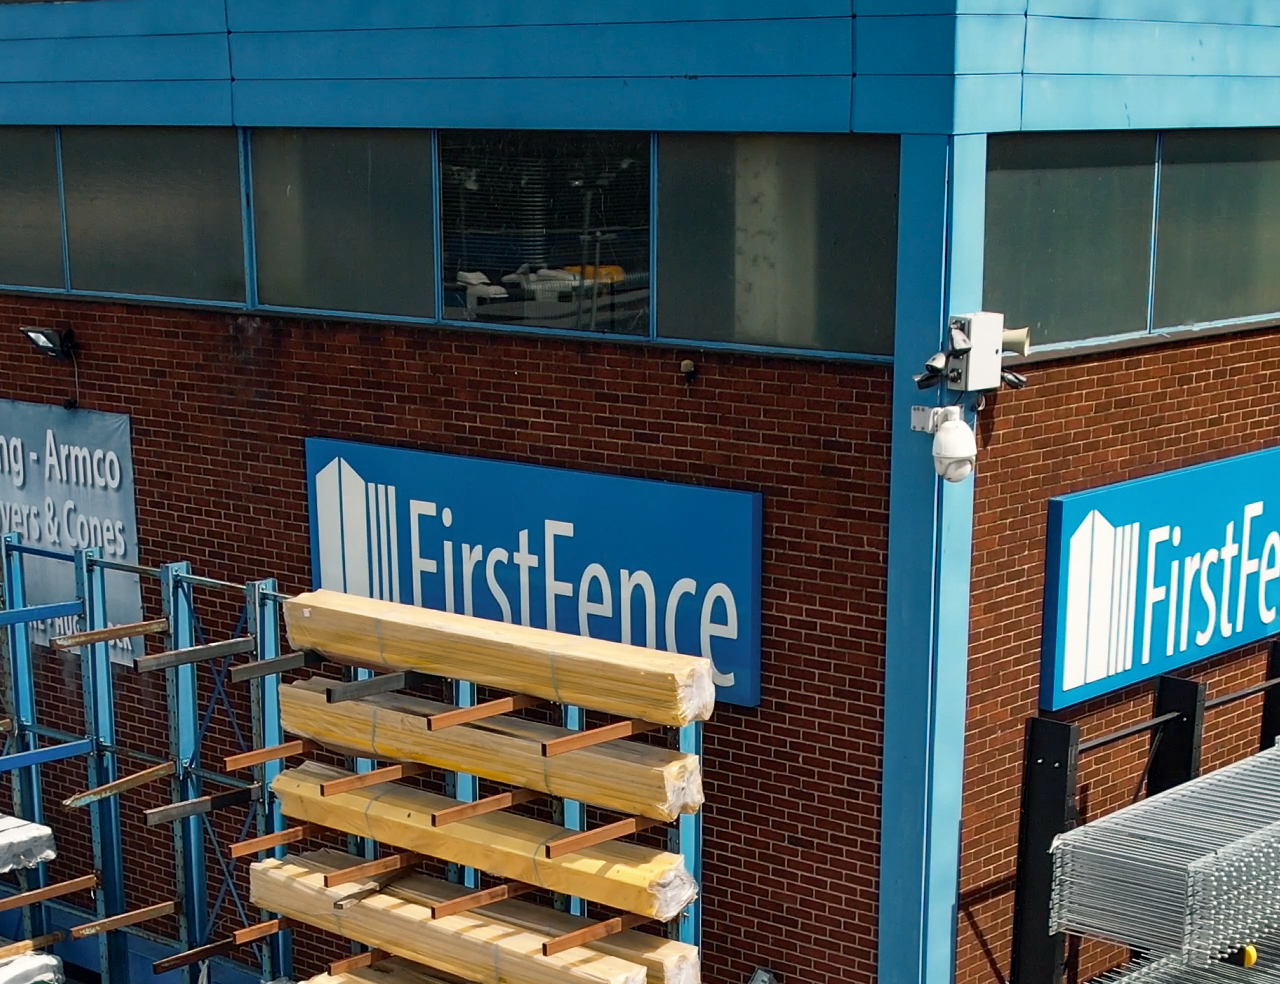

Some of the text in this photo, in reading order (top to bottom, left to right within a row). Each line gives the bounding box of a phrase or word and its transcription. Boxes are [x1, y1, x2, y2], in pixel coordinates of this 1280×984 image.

[45, 429, 121, 489] Armco
[44, 497, 59, 544] &
[63, 500, 126, 556] Cones
[409, 498, 739, 687] FirstFence
